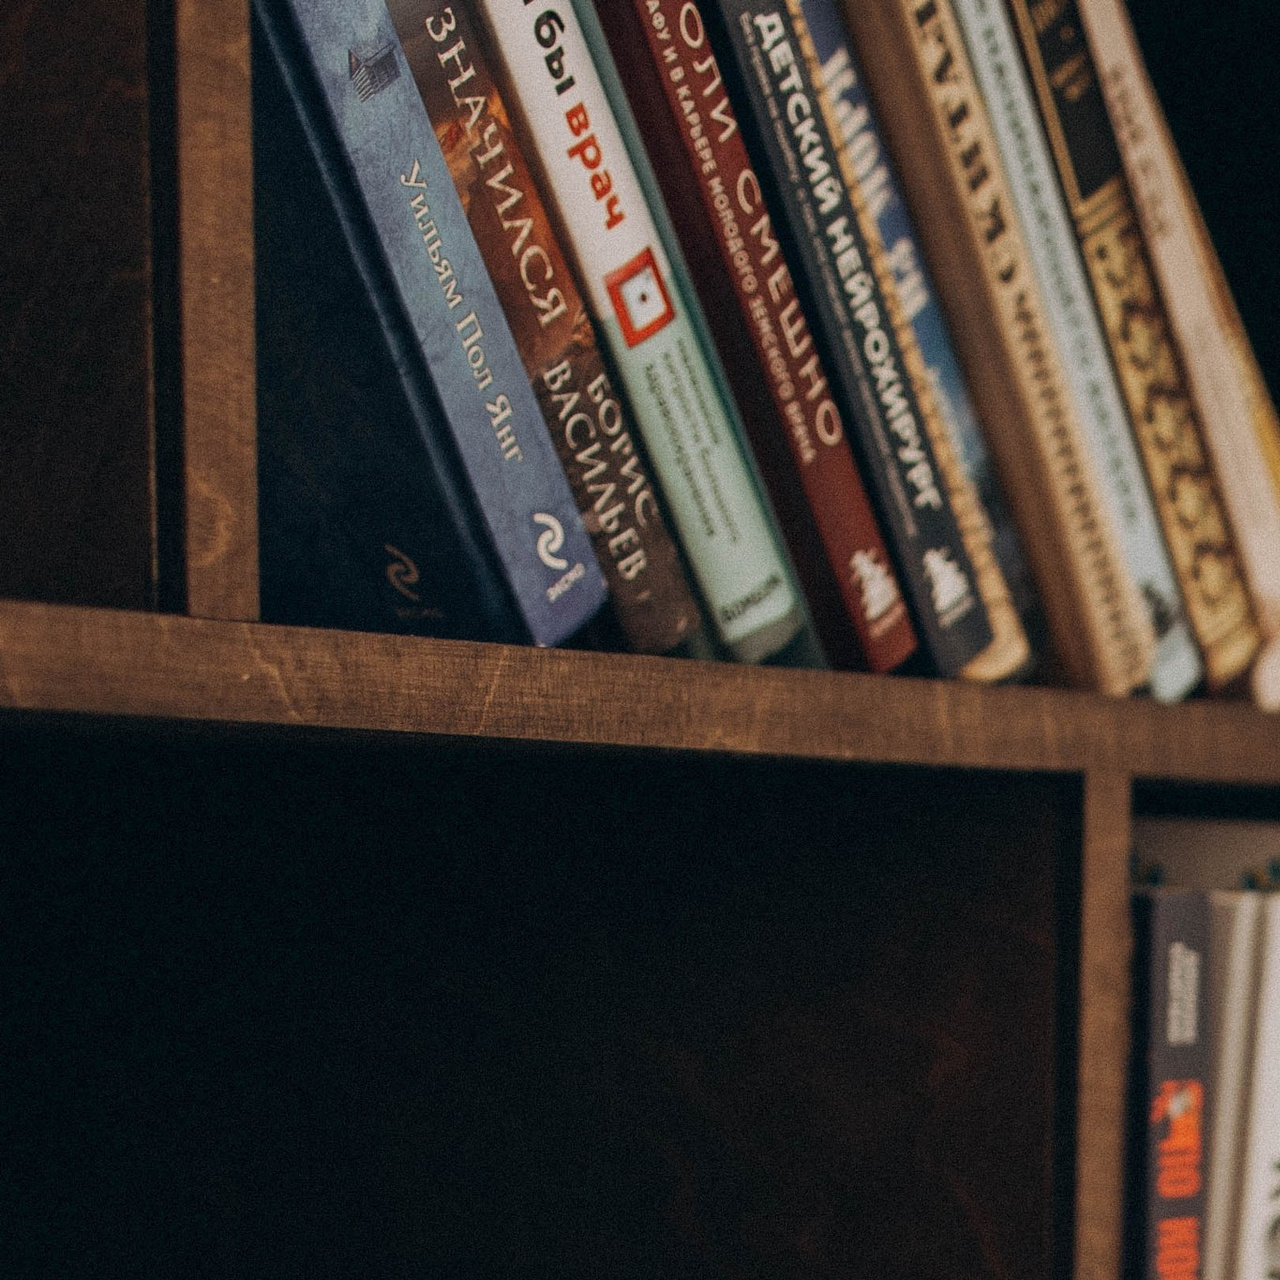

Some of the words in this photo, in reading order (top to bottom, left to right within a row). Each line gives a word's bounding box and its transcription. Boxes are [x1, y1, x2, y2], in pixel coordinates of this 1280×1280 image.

[426, 6, 568, 326] ЗНАЧИЛСЯ
[534, 8, 576, 96] бы
[565, 101, 626, 231] врач
[663, 46, 680, 66] И
[668, 67, 684, 84] В
[676, 77, 717, 187] КАРЬЕРЕ
[401, 158, 463, 311] Уильям
[454, 310, 493, 391] Пол
[485, 394, 524, 464] Янг
[709, 175, 759, 295] МОЛОДОГО
[736, 168, 843, 447] СМЕШНО
[754, 11, 843, 216] ДЕТСКИЙ
[826, 216, 941, 510] НЕЙРОХИРУРГ
[543, 360, 648, 582] ВАСИЛЬЕВ
[586, 372, 658, 528] БОРИС
